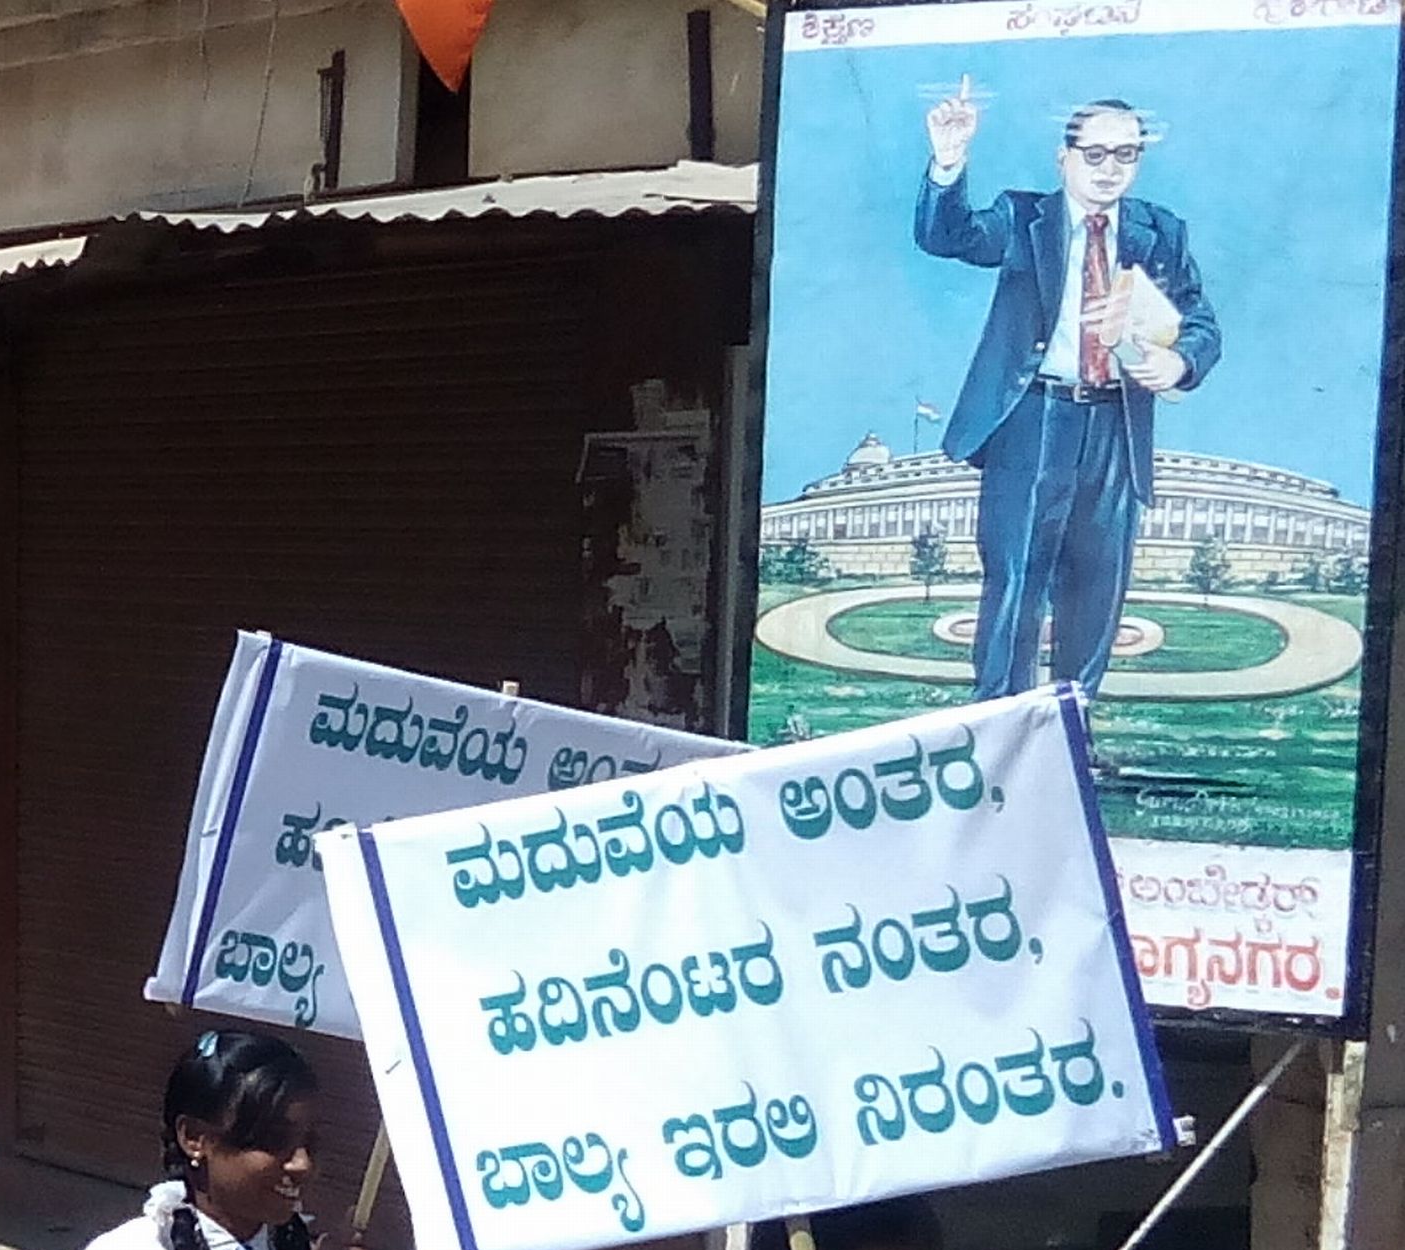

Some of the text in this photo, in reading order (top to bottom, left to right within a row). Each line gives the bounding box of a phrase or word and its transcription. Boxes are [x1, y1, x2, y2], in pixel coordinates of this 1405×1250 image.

[309, 682, 527, 785] ಮದುವೆಯ
[445, 782, 749, 909] ಮದುವೆಯ
[780, 722, 1005, 843] ಅಂತರ,
[214, 930, 324, 1028] ಬಾಲ್ಯ
[479, 875, 1045, 1056] ಹದಿನೆಂಟರ ನಂತರ,
[1131, 926, 1342, 1009] ಾಗ್ಯನಗರ.
[475, 1018, 1130, 1236] ಬಾಲ್ಯ ಇರಲಿ ನಿರಂತರ.
